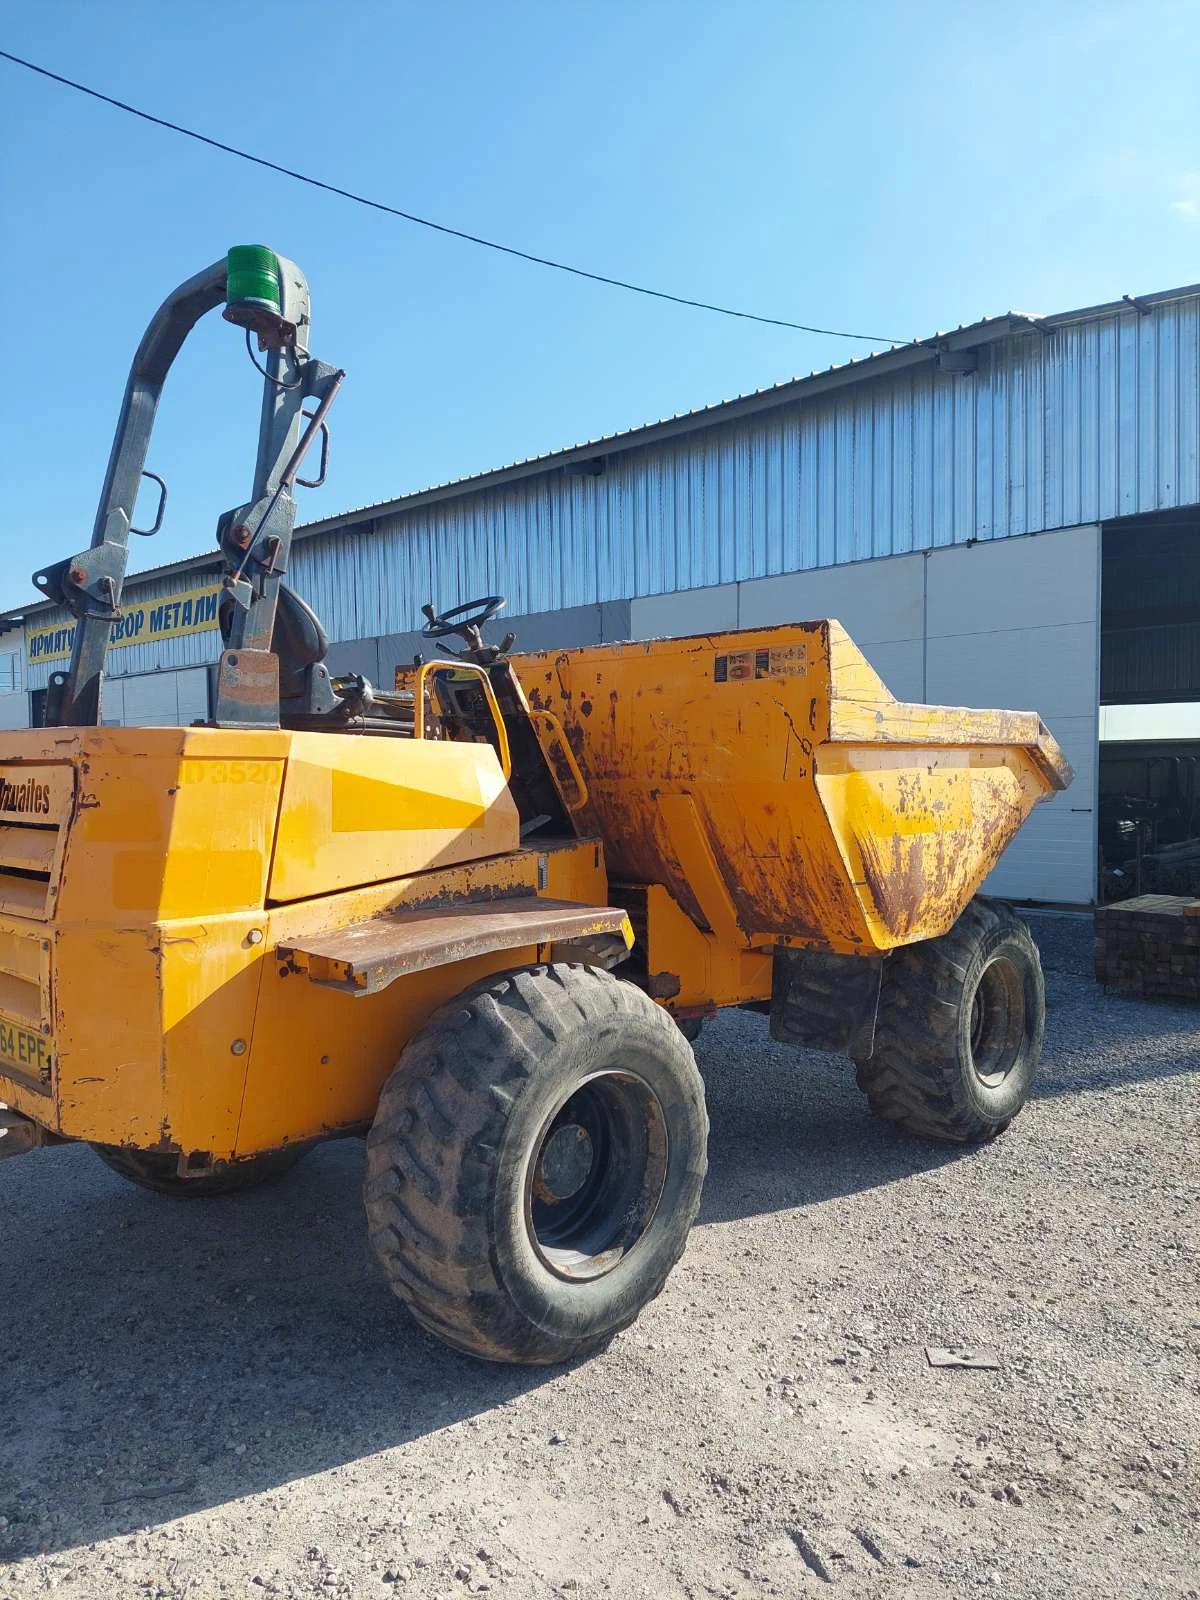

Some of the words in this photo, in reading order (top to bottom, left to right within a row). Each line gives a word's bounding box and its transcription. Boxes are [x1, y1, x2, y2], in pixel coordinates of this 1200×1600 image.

[31, 626, 76, 657] АРМАТУ
[149, 593, 217, 633] МЕТАЛИ
[0, 777, 50, 814] hwaites
